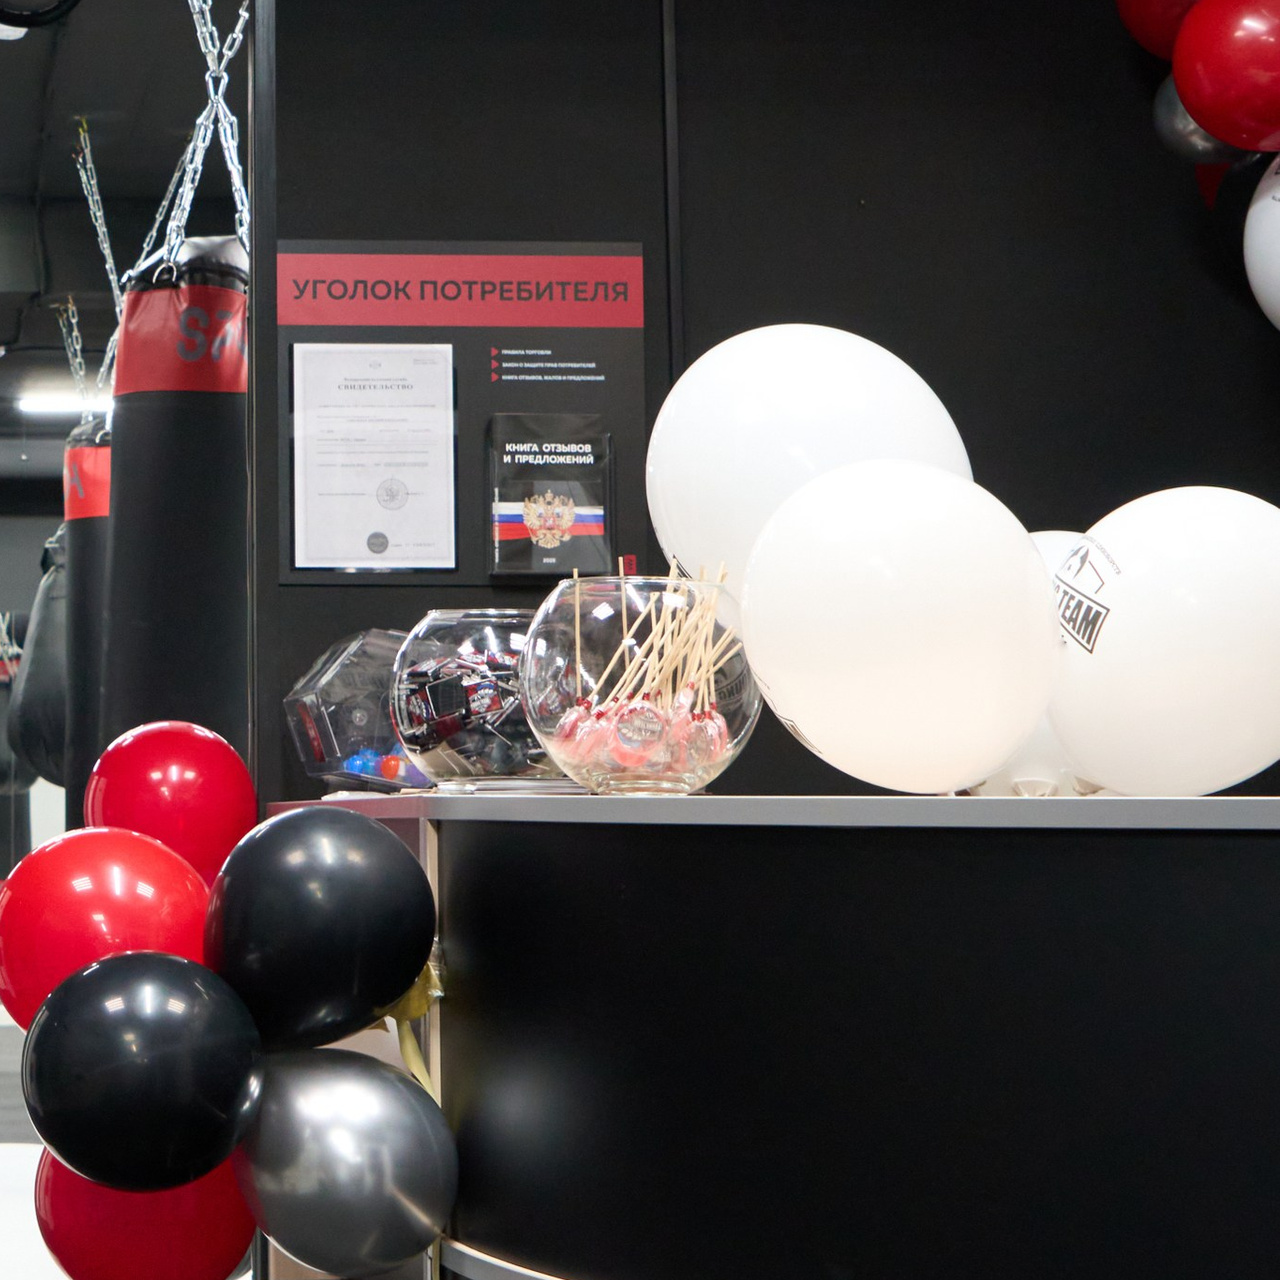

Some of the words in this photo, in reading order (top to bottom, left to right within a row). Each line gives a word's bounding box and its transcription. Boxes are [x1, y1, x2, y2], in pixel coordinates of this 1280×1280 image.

[292, 279, 411, 301] УГОЛОК
[419, 279, 629, 303] ПОТРЕБИТЕЛЯ
[505, 443, 539, 453] КНИГА
[542, 443, 592, 453] ОТЗЫВОВ
[503, 455, 511, 464] И
[515, 454, 594, 465] ПРЕДЛОЖЕНИЙ
[1058, 589, 1103, 646] TEAM
